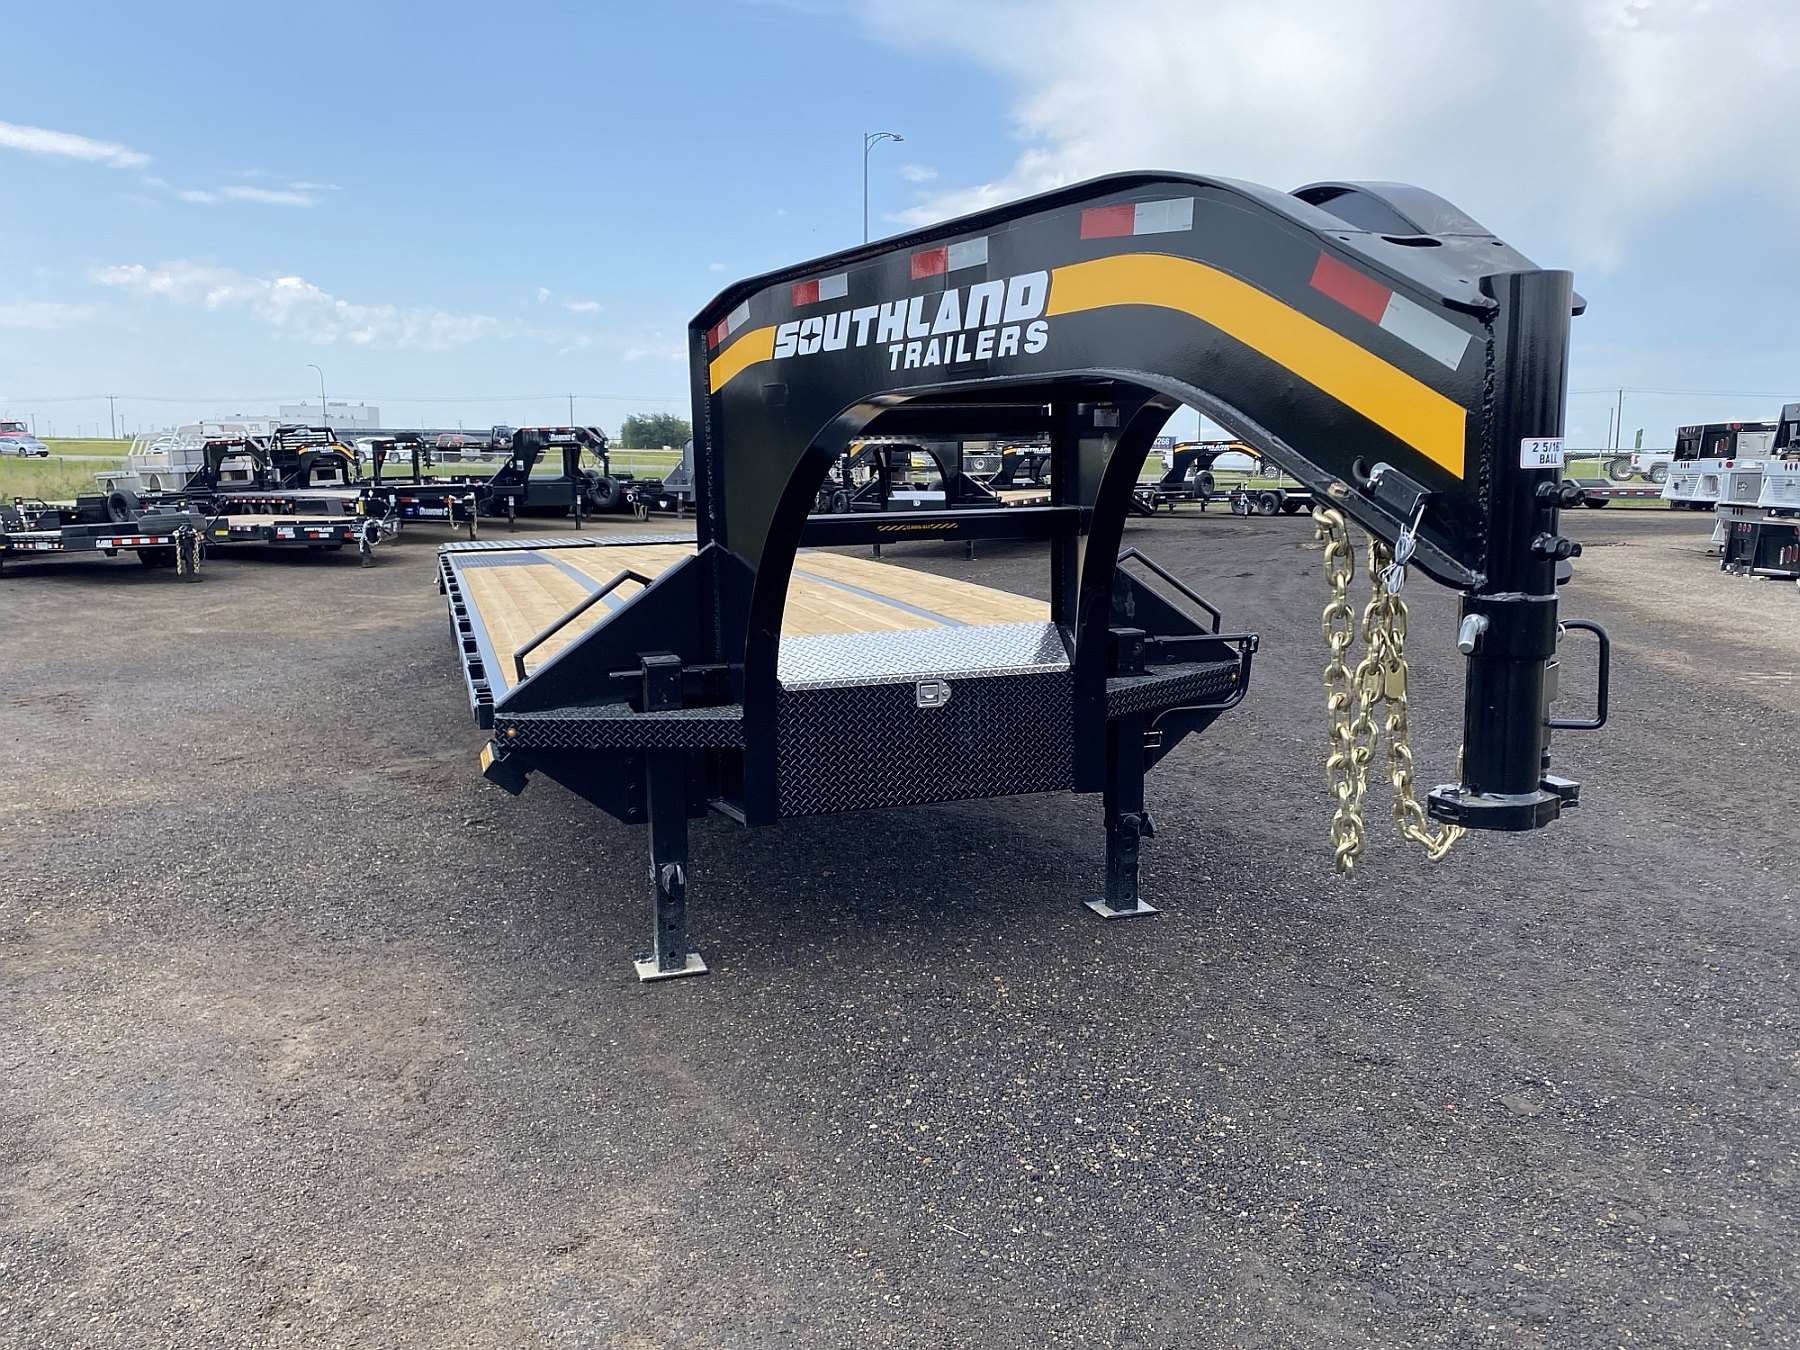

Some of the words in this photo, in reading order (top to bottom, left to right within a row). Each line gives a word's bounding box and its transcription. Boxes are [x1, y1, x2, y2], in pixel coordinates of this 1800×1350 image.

[773, 270, 1050, 360] SOUTHLAND
[888, 319, 1049, 371] TRAILERS
[1532, 442, 1539, 453] 2
[1539, 453, 1558, 464] BALL
